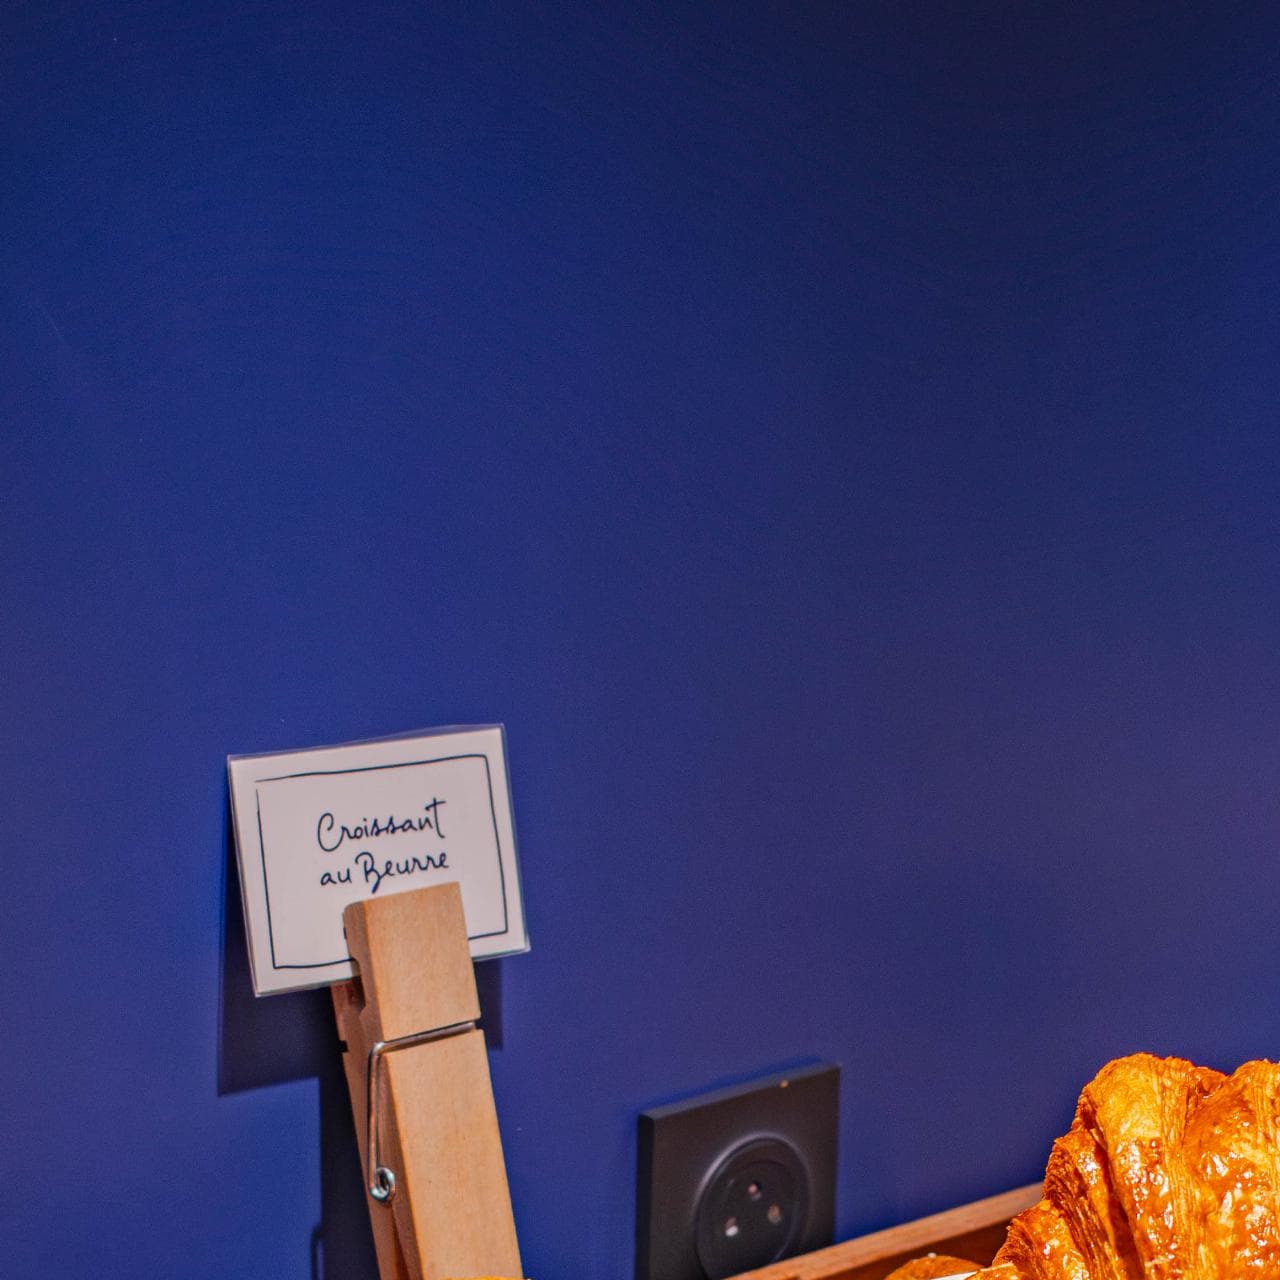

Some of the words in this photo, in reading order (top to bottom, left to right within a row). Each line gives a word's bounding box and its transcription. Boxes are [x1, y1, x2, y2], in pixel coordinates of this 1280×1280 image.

[317, 797, 447, 853] Croissant
[320, 867, 352, 886] au
[354, 851, 450, 894] Beurre
